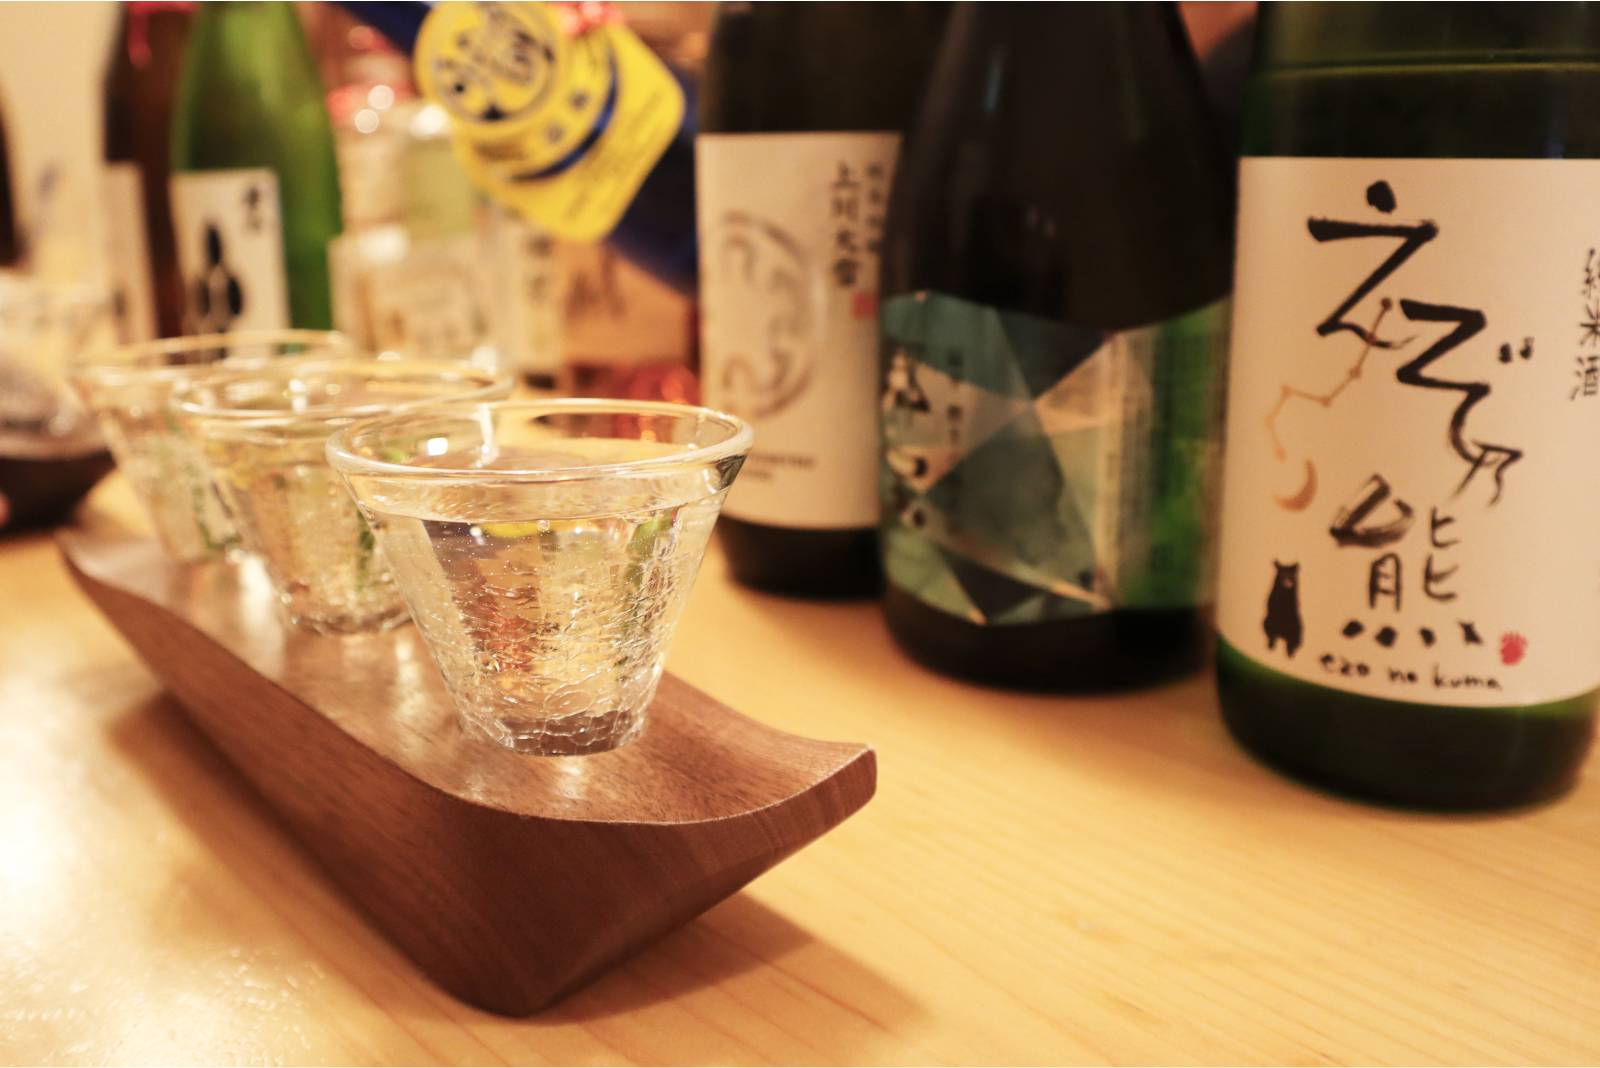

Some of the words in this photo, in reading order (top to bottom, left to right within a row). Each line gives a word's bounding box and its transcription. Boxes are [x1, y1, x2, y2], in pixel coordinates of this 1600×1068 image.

[1319, 653, 1371, 677] ezo
[1387, 666, 1418, 683] no
[1433, 662, 1503, 690] kuma
